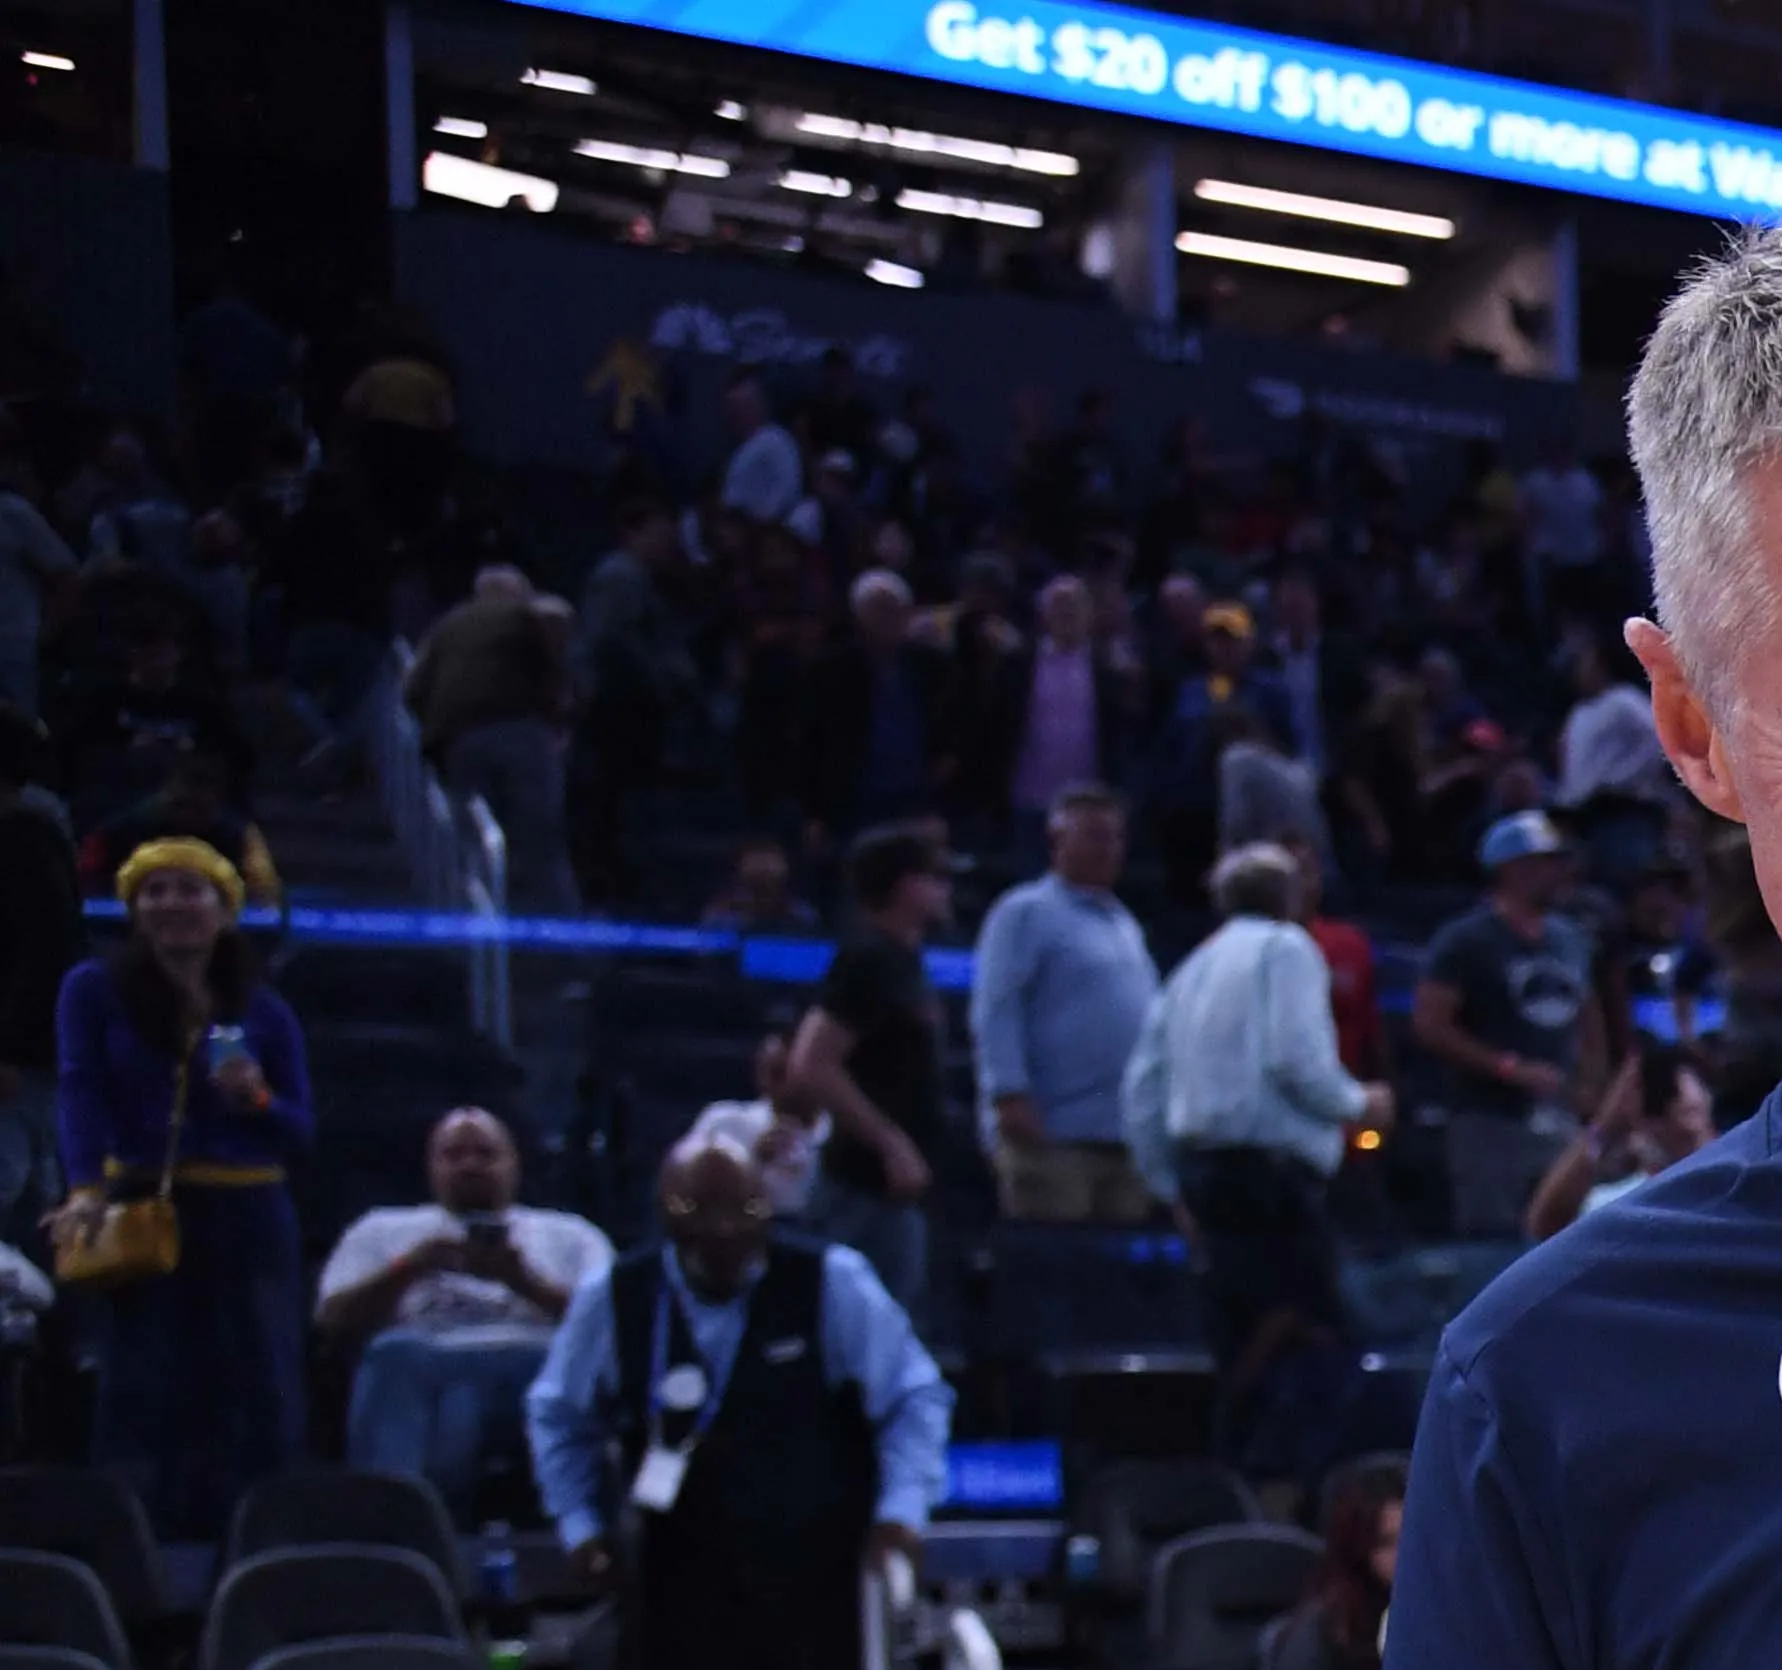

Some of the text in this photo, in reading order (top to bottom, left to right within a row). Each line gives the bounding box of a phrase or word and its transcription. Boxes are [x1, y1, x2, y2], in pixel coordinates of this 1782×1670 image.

[928, 1, 1046, 73] Get
[1053, 22, 1167, 94] $20
[1175, 47, 1268, 111] off
[1272, 63, 1412, 138] $100
[1416, 97, 1484, 150] or
[1490, 112, 1638, 178] more
[1645, 136, 1707, 193] at
